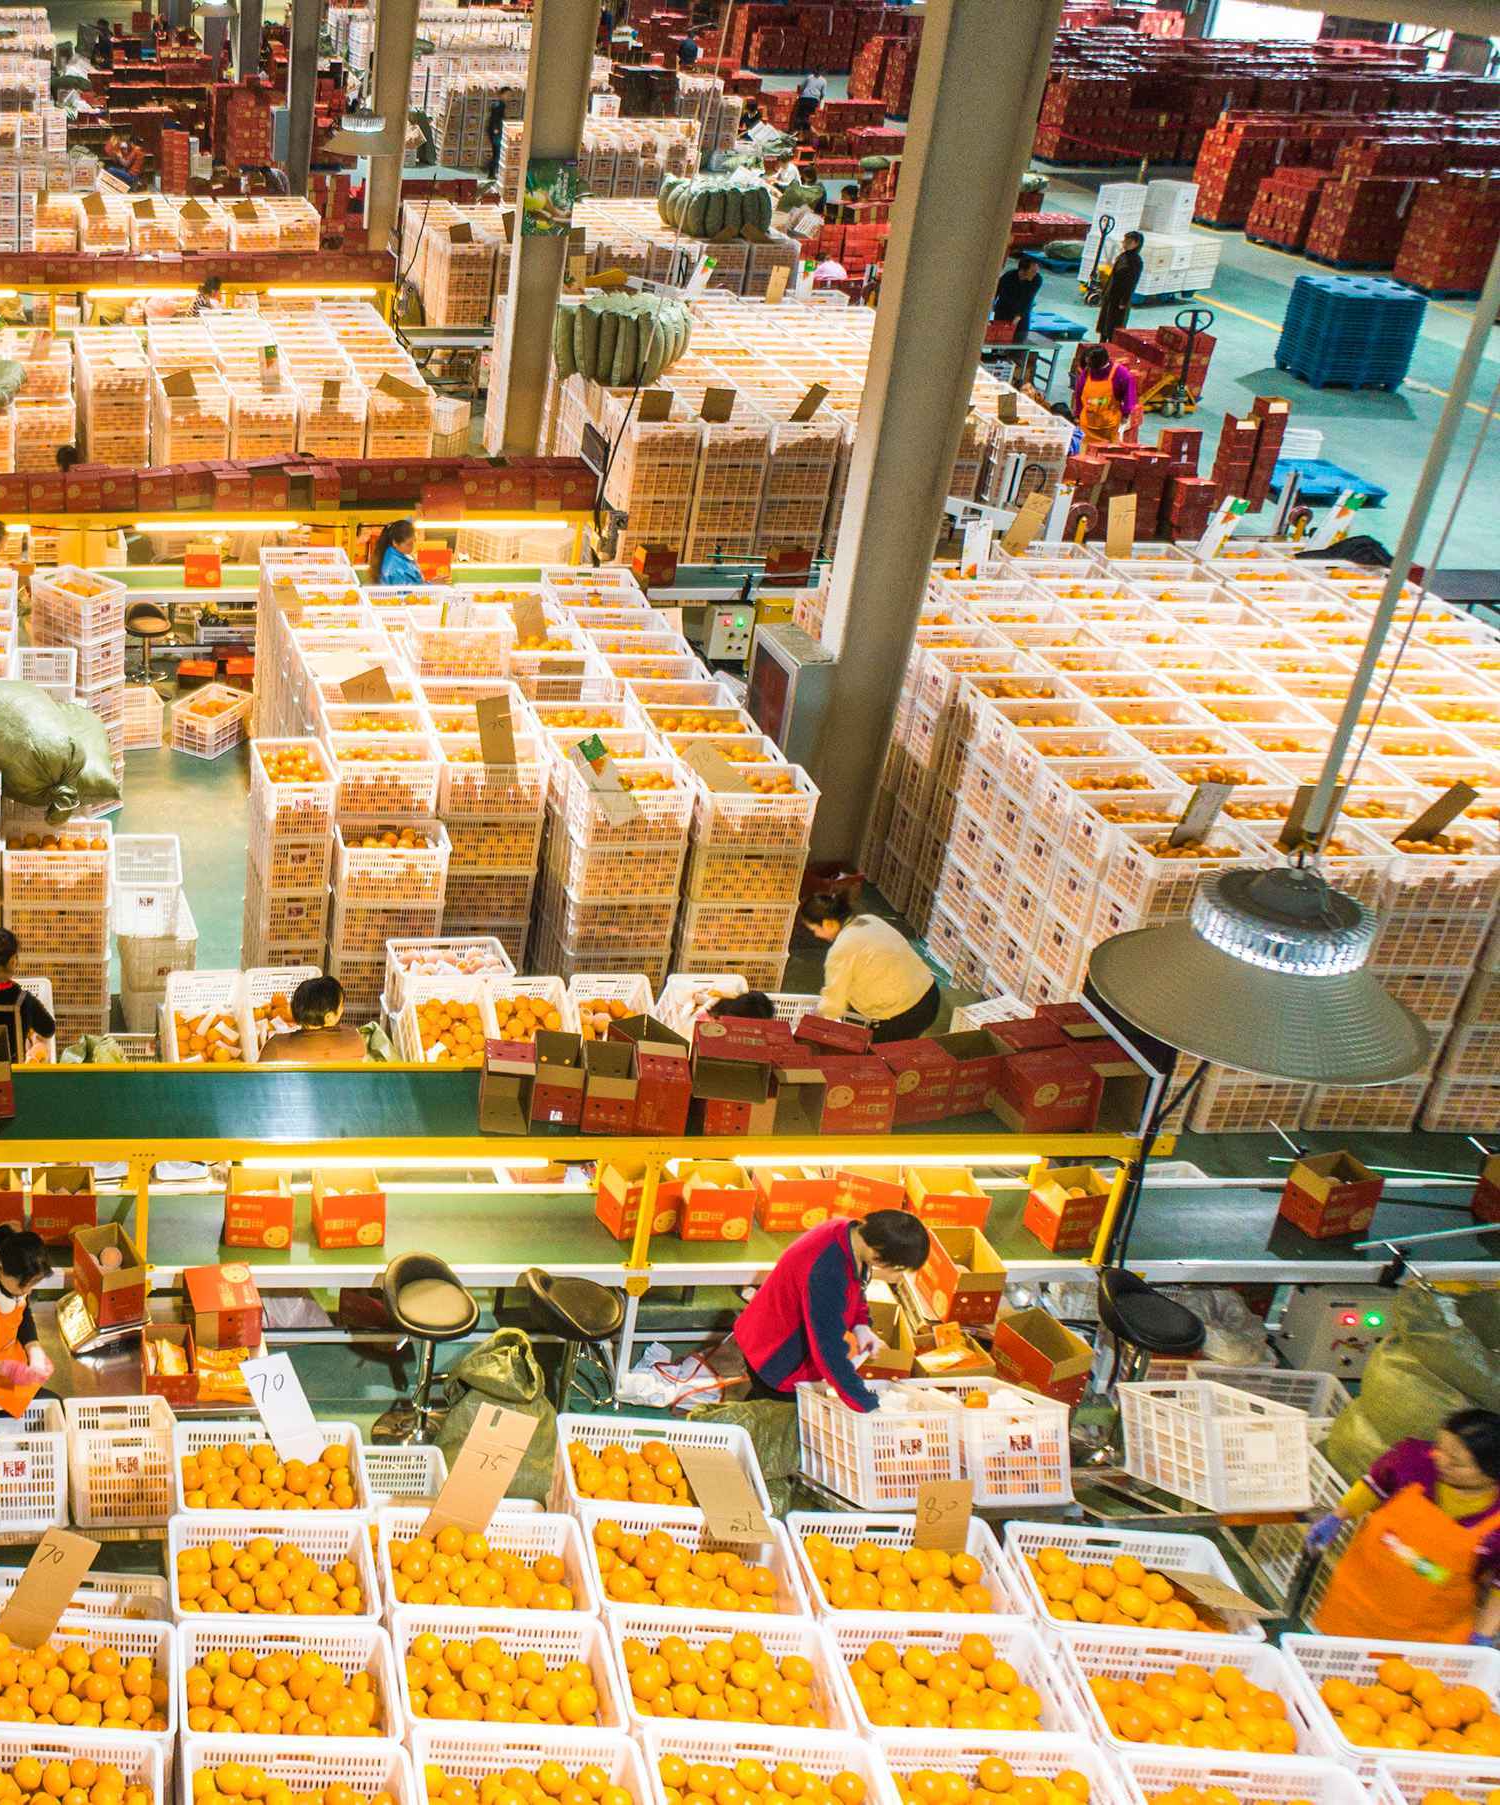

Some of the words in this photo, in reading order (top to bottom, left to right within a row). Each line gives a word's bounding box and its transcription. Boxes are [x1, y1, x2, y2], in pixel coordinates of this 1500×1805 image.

[250, 1373, 285, 1404] 70
[474, 1451, 509, 1472] 75
[39, 1543, 65, 1565] 70
